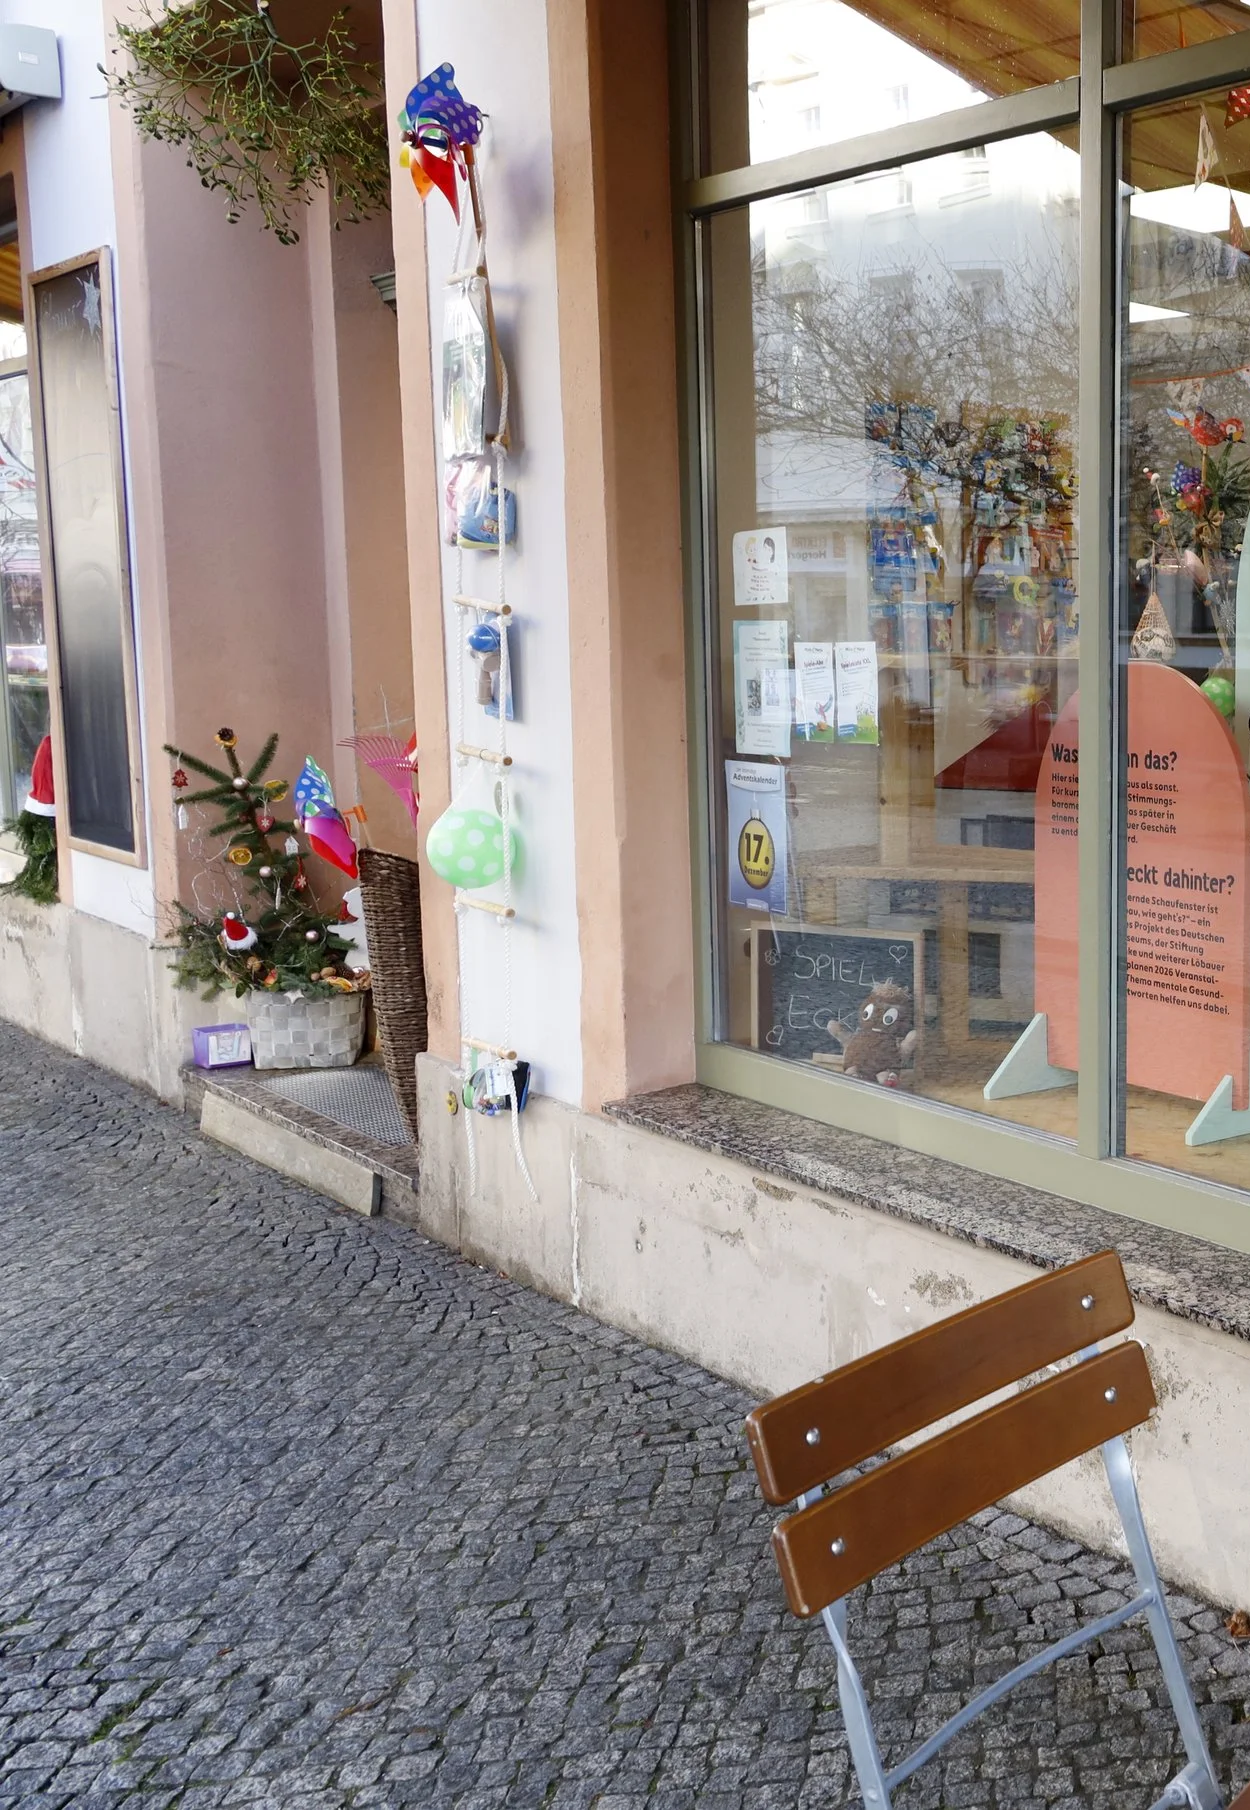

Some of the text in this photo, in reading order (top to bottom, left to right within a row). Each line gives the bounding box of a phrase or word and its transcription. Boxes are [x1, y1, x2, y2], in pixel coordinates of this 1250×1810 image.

[1051, 743, 1079, 763] Was
[1144, 750, 1177, 771] das?
[733, 773, 777, 785] Adventskalender
[1052, 773, 1179, 792] Hier sonst.
[1128, 794, 1176, 807] Stimmungs-
[1052, 814, 1075, 823] einem
[1141, 822, 1177, 834] Geschäft
[1139, 810, 1165, 819] später
[745, 832, 770, 866] 17.
[744, 865, 768, 877] Dezember
[1127, 864, 1235, 895] eckt dahinter?
[1152, 896, 1205, 913] Schaufenster
[1135, 921, 1164, 934] Projekt
[1165, 927, 1180, 936] des
[1181, 928, 1225, 943] Deutschen
[1155, 938, 1204, 956] der Stiftung
[794, 945, 875, 986] SPIEL
[1139, 950, 1153, 959] und
[1155, 953, 1189, 965] weiterer
[1191, 957, 1225, 972] Löbauer
[1155, 965, 1219, 984] 2026 Veranstal-
[1154, 979, 1224, 999] mentale Gesund-
[789, 994, 861, 1031] ECK
[1160, 994, 1230, 1015] helfen uns dabei.
